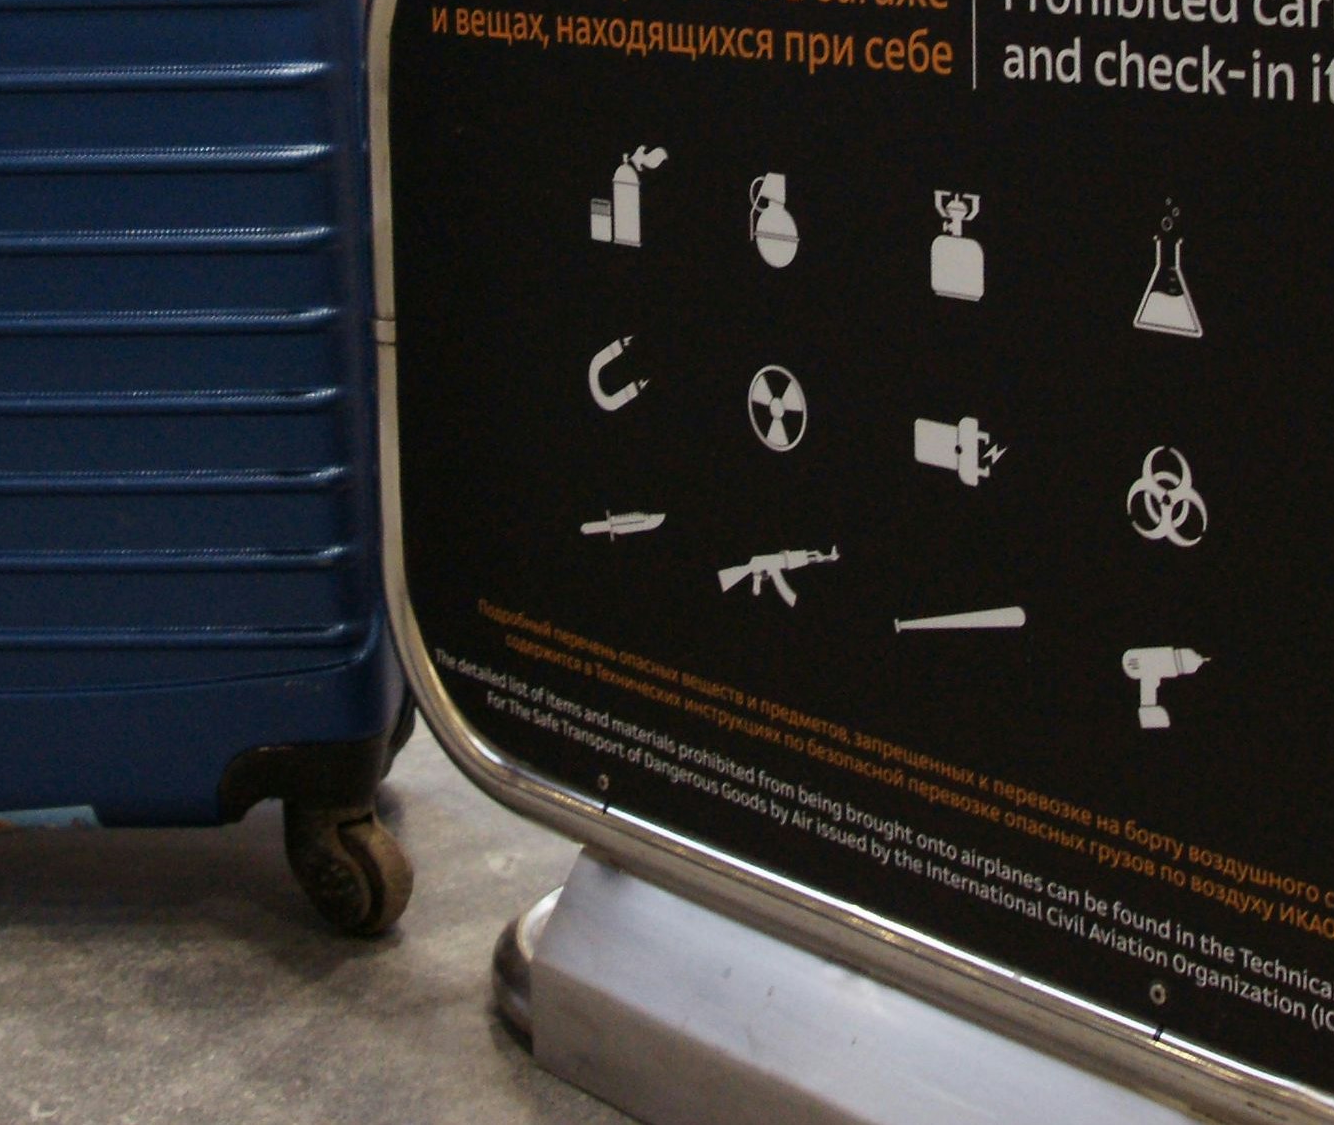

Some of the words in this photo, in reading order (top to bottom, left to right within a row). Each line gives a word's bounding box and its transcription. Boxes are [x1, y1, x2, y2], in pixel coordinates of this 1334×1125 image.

[431, 6, 448, 34] и
[455, 6, 550, 49] вещах,
[556, 14, 773, 60] находящихся
[784, 31, 853, 74] при
[865, 27, 954, 76] себе
[1003, 37, 1082, 84] and
[1094, 40, 1295, 102] check-in
[434, 649, 455, 669] The
[457, 659, 507, 689] detailed
[508, 675, 528, 697] list
[531, 687, 544, 701] of
[546, 693, 583, 719] items
[584, 709, 609, 729] and
[611, 719, 675, 755] materials
[677, 745, 755, 783] prohibited
[757, 769, 795, 799] from
[797, 785, 842, 819] being
[845, 803, 913, 845] brought
[916, 833, 957, 861] onto
[960, 849, 1043, 893] airplanes
[1047, 881, 1079, 905] can
[1084, 891, 1107, 917] be
[1112, 901, 1171, 939] found
[1175, 923, 1195, 949] in
[1199, 935, 1235, 963] the
[486, 691, 505, 709] For
[509, 699, 531, 721] The
[532, 709, 559, 731] Safe
[561, 719, 625, 759] Transport
[627, 747, 643, 763] of
[643, 751, 719, 795] Dangerous
[721, 783, 765, 813] Goods
[770, 799, 789, 825] by
[791, 809, 811, 831] Air
[815, 821, 867, 853] issued
[871, 837, 892, 865] by
[894, 849, 923, 873] the
[925, 861, 1043, 921] International
[1046, 907, 1085, 937] Civil
[1088, 923, 1167, 967] Aviation
[1171, 953, 1306, 1019] Organization
[682, 673, 743, 705] веществ
[746, 695, 757, 709] и
[760, 699, 850, 745] предметов,
[978, 775, 988, 791] к
[993, 781, 1091, 827] перевозке
[1096, 815, 1120, 835] на
[1124, 819, 1184, 861] борту
[1188, 845, 1319, 903] воздушного
[684, 699, 780, 743] инструкциях
[783, 733, 803, 751] по
[807, 739, 903, 787] безопасной
[908, 779, 1000, 821] перевозке
[1004, 811, 1085, 851] опасных
[1089, 841, 1155, 877] грузов
[1160, 865, 1186, 887] по
[1190, 875, 1275, 921] воздуху
